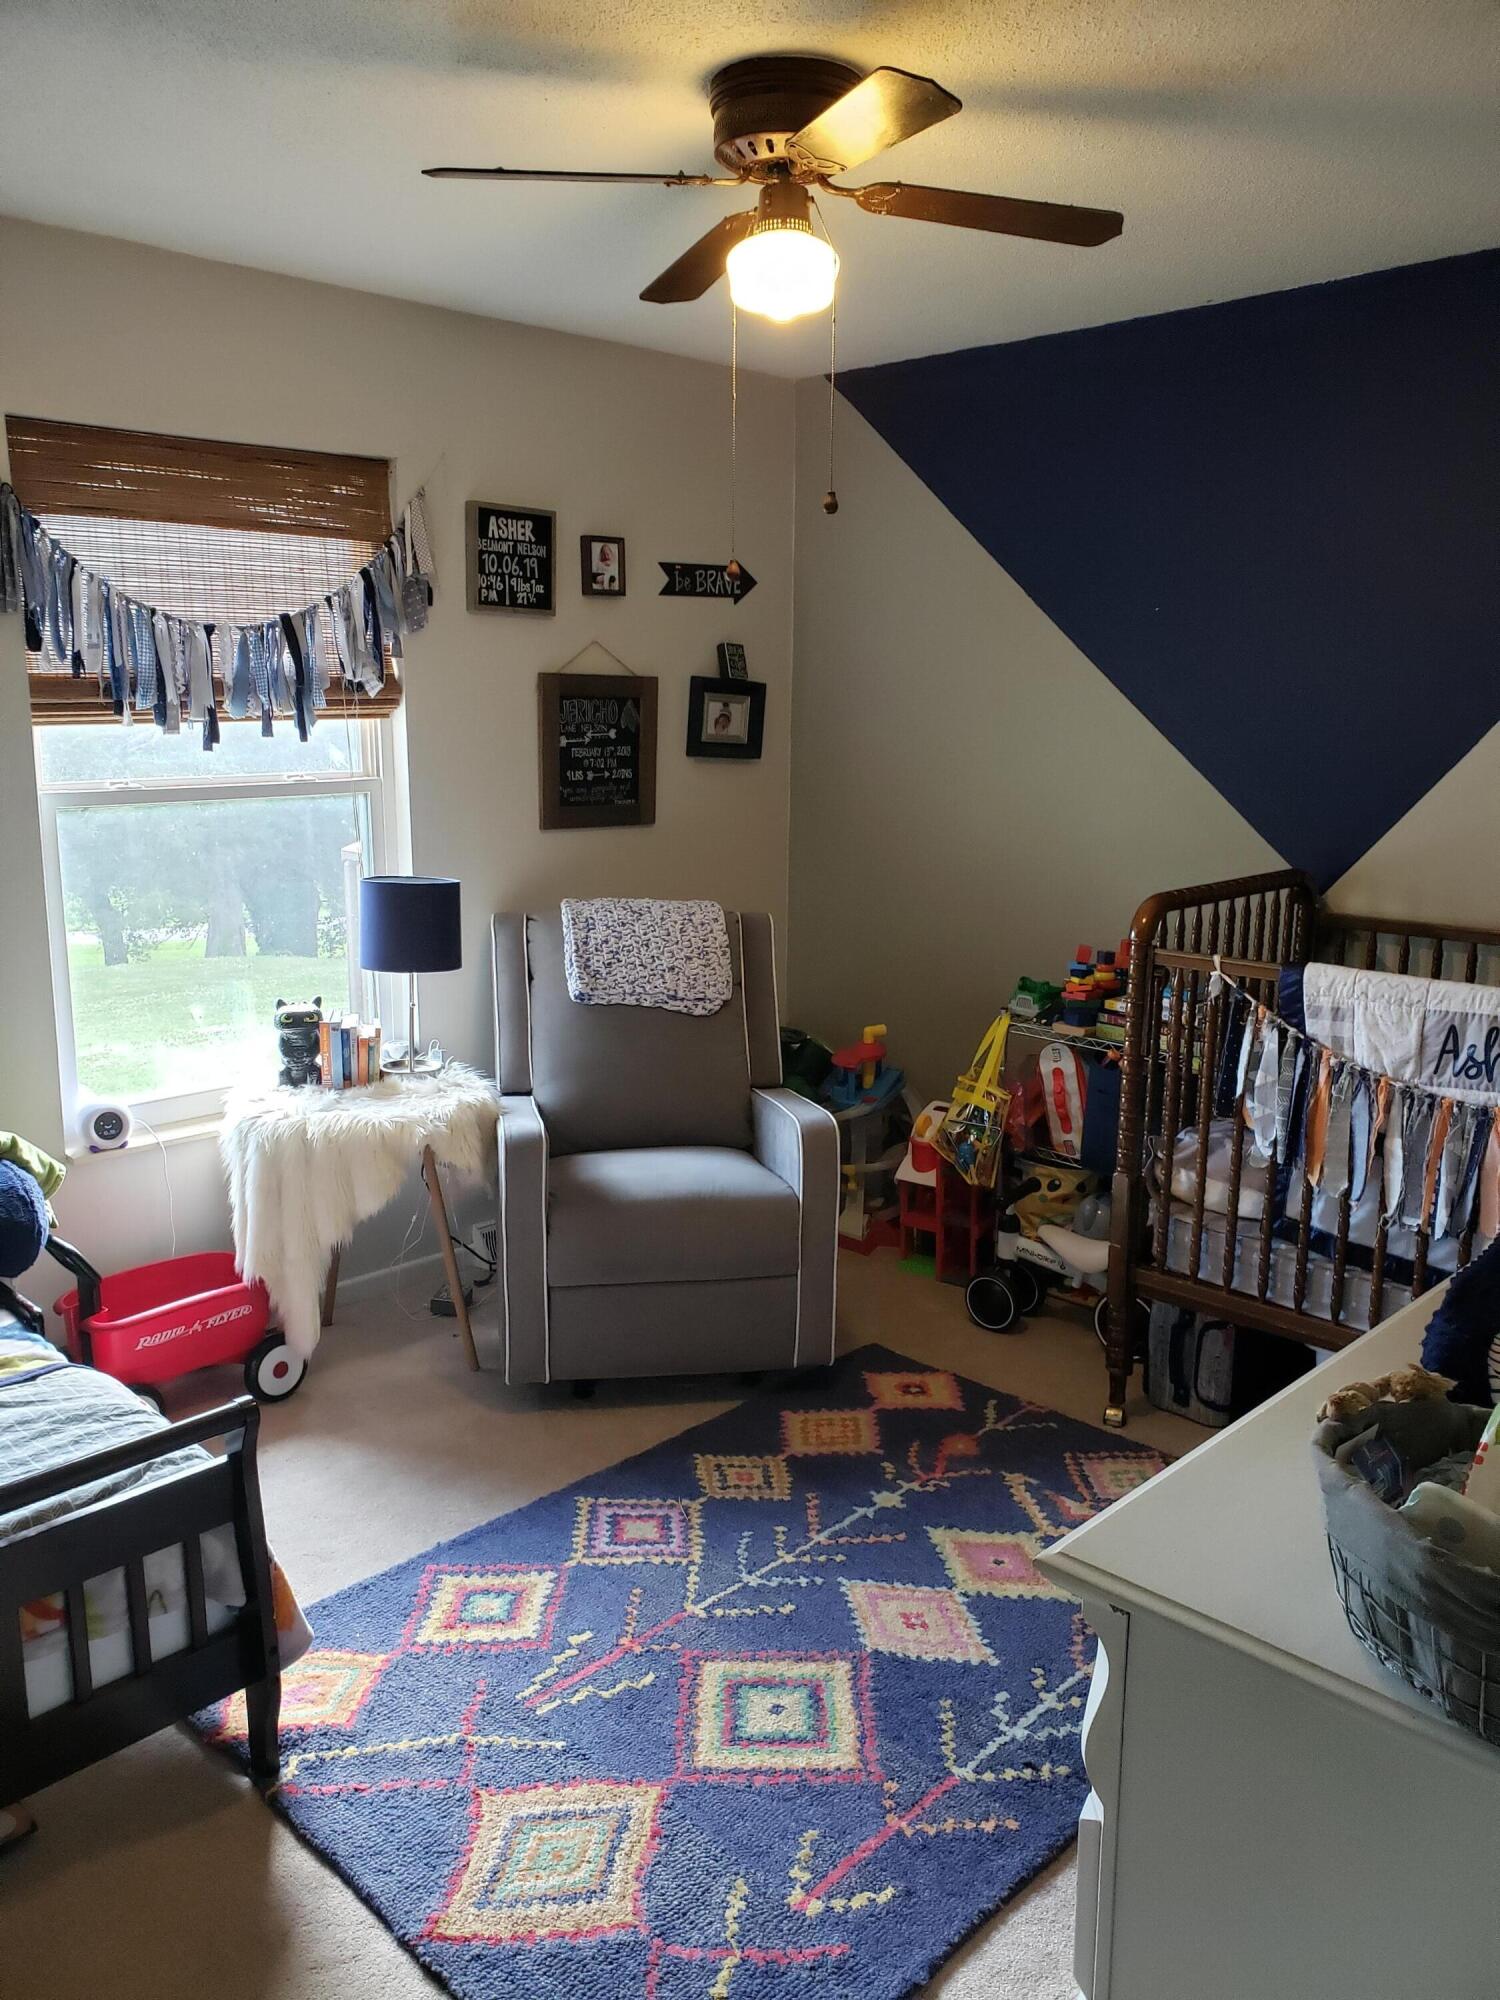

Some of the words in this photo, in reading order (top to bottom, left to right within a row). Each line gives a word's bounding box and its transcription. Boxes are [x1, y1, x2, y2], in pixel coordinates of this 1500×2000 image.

[488, 515, 536, 542] ASHER
[517, 542, 547, 559] NELSON
[482, 553, 539, 579] 10.06.19
[674, 570, 692, 593] be
[695, 569, 741, 595] BRAVE
[481, 588, 499, 602] PM
[560, 697, 619, 725] JERICHO
[580, 722, 608, 734] NELSON
[571, 747, 602, 759] FEBRUARY
[590, 757, 605, 768] 7:02
[135, 1325, 187, 1351] RADIO
[205, 1304, 253, 1330] FLYER
